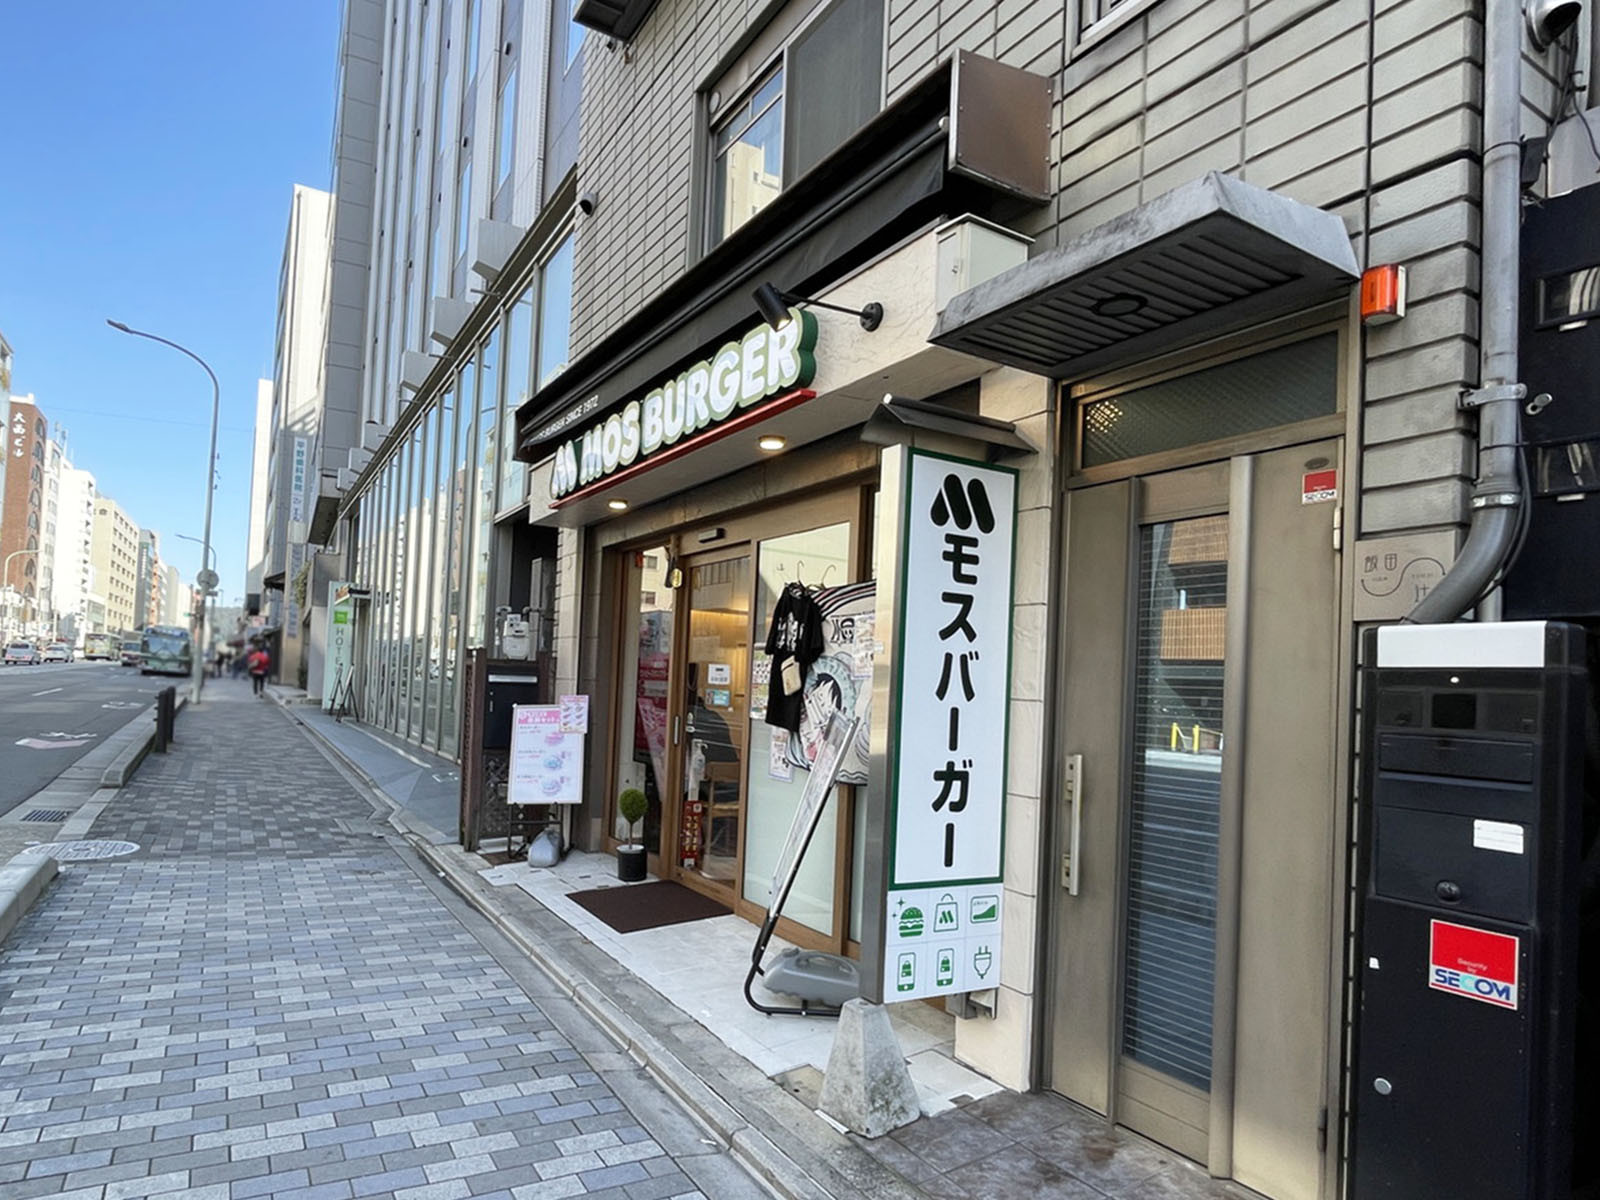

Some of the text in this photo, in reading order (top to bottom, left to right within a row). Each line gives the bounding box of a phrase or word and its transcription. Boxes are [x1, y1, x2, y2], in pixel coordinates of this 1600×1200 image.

[579, 402, 640, 484] MOS
[642, 308, 803, 455] BURGER
[932, 533, 980, 868] モスバーガー
[1435, 968, 1511, 1001] SECOM
[1457, 958, 1489, 971] Security
